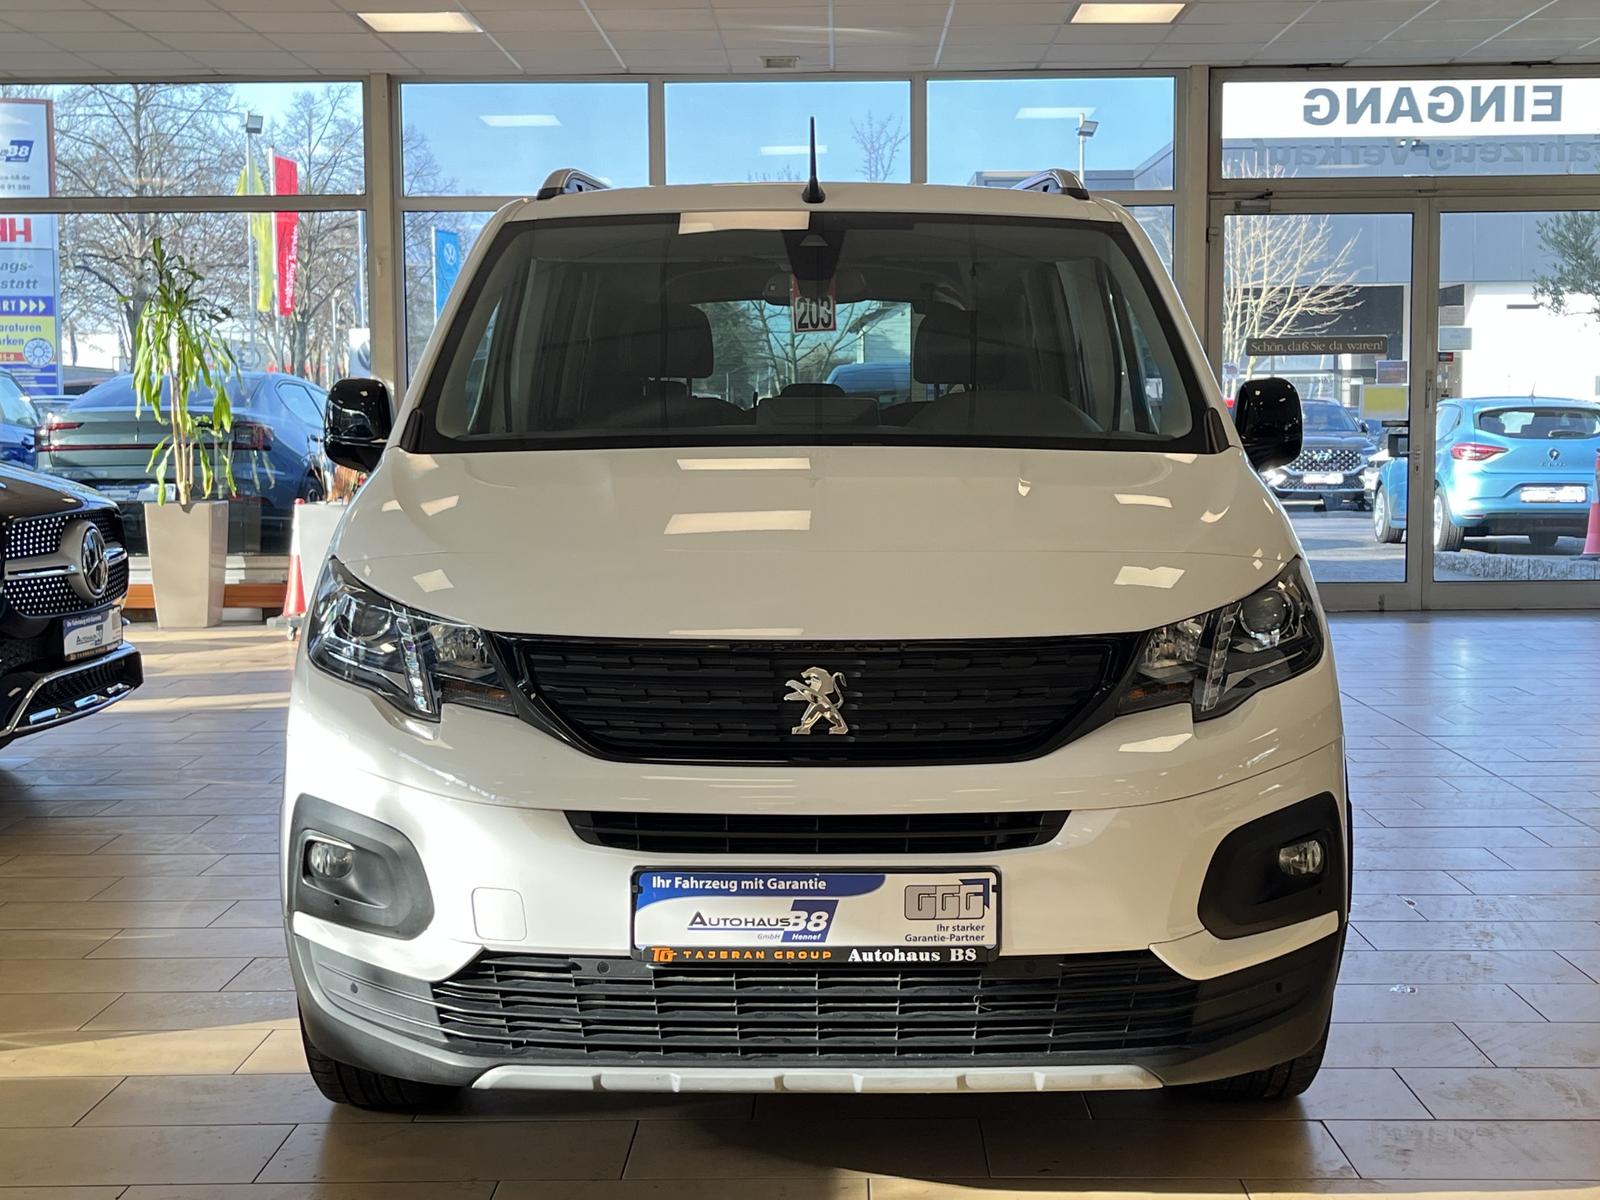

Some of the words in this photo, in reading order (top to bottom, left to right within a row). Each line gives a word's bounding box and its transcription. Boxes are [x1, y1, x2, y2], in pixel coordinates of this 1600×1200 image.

[0, 300, 16, 311] RT
[797, 297, 832, 329] 203
[1329, 341, 1343, 351] da
[1347, 340, 1383, 351] waren!
[652, 876, 671, 889] Ihr
[674, 877, 737, 892] Fahrzeug
[741, 878, 765, 890] mit
[767, 878, 827, 891] Garantie
[936, 924, 950, 932] Ihr
[952, 923, 985, 932] starker
[791, 932, 822, 940] Hennef
[904, 933, 985, 943] Garantie-Partner
[774, 951, 832, 960] GROUP
[848, 948, 941, 962] Autohaus
[950, 948, 977, 961] B8
